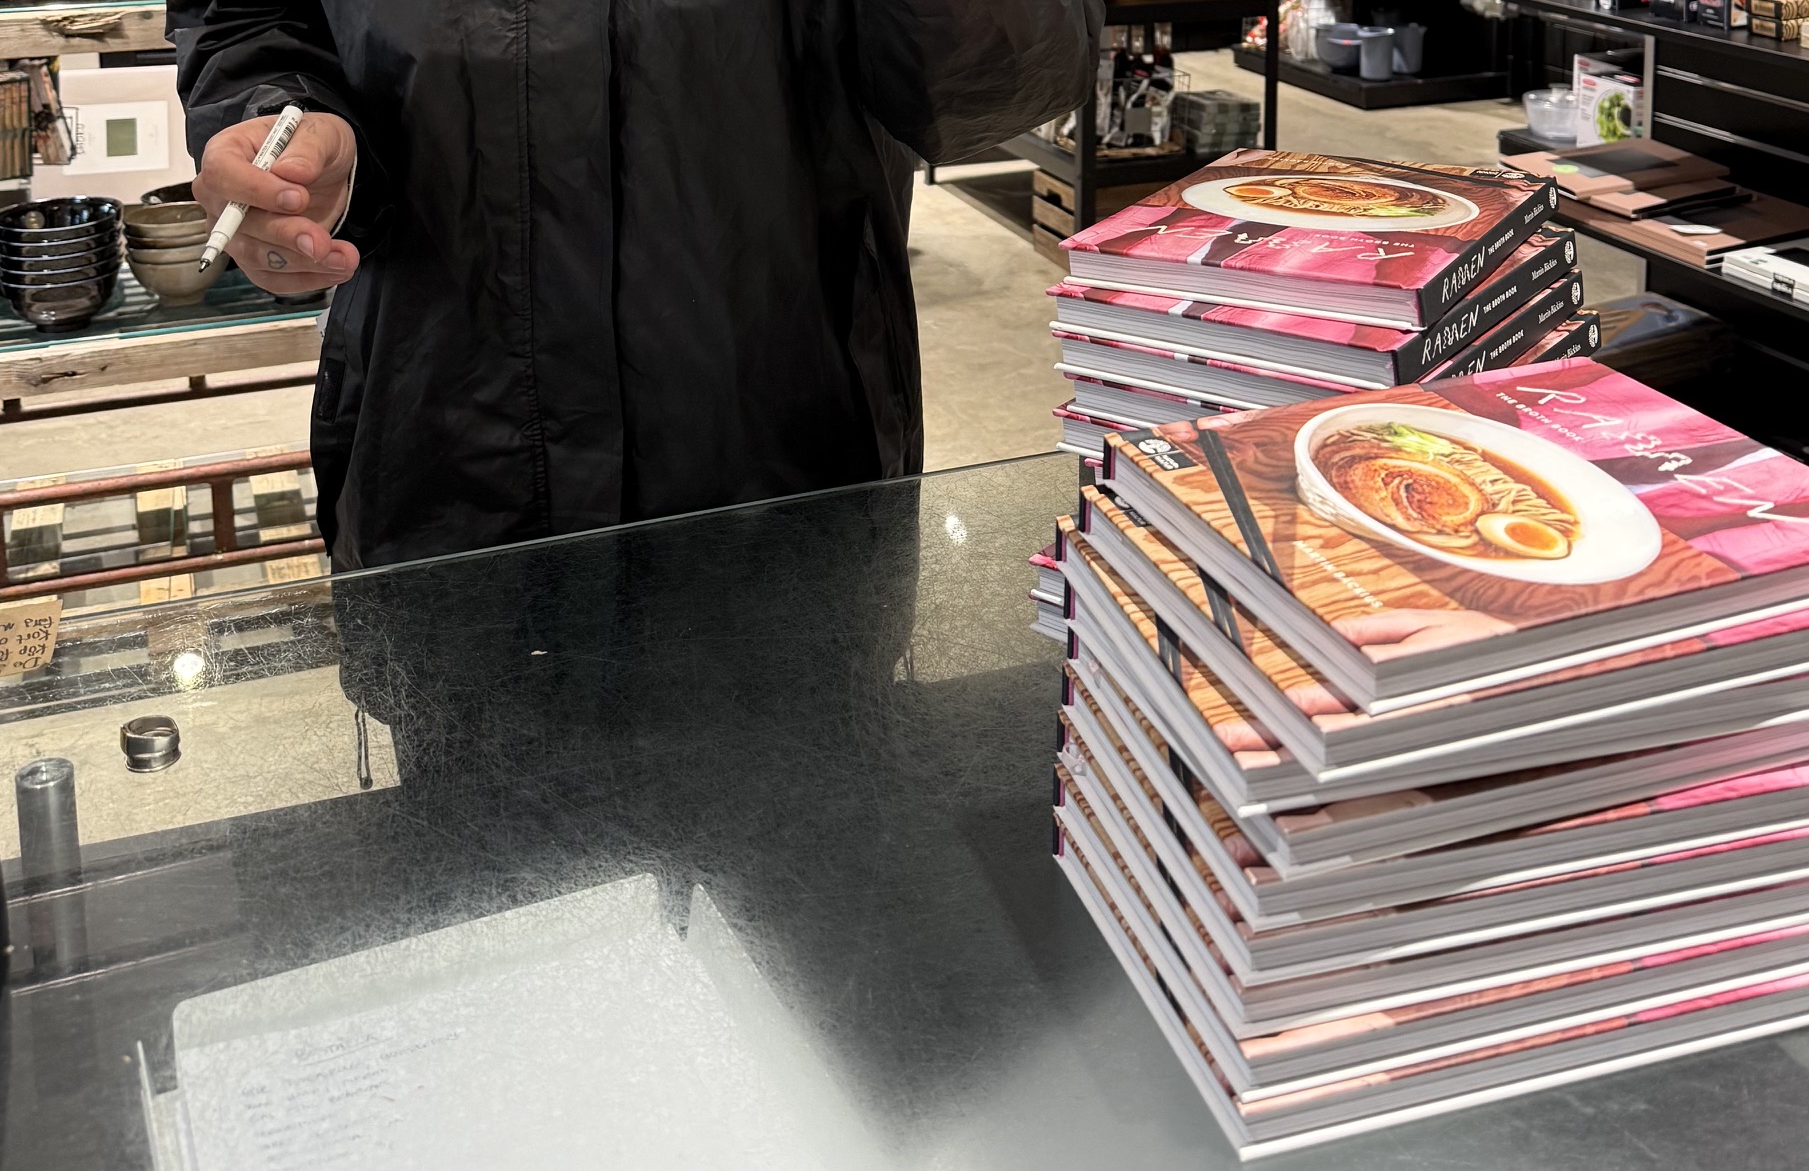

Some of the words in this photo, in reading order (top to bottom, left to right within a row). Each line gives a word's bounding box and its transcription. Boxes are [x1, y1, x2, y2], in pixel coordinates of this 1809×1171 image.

[1441, 245, 1486, 304] RAMEN
[1421, 304, 1480, 366] RAMEN
[1496, 391, 1518, 405] THE
[1515, 403, 1553, 424] BROTH
[1550, 423, 1584, 442] BOOK
[1516, 385, 1809, 523] RAMEN
[1291, 539, 1336, 572] MARTIN
